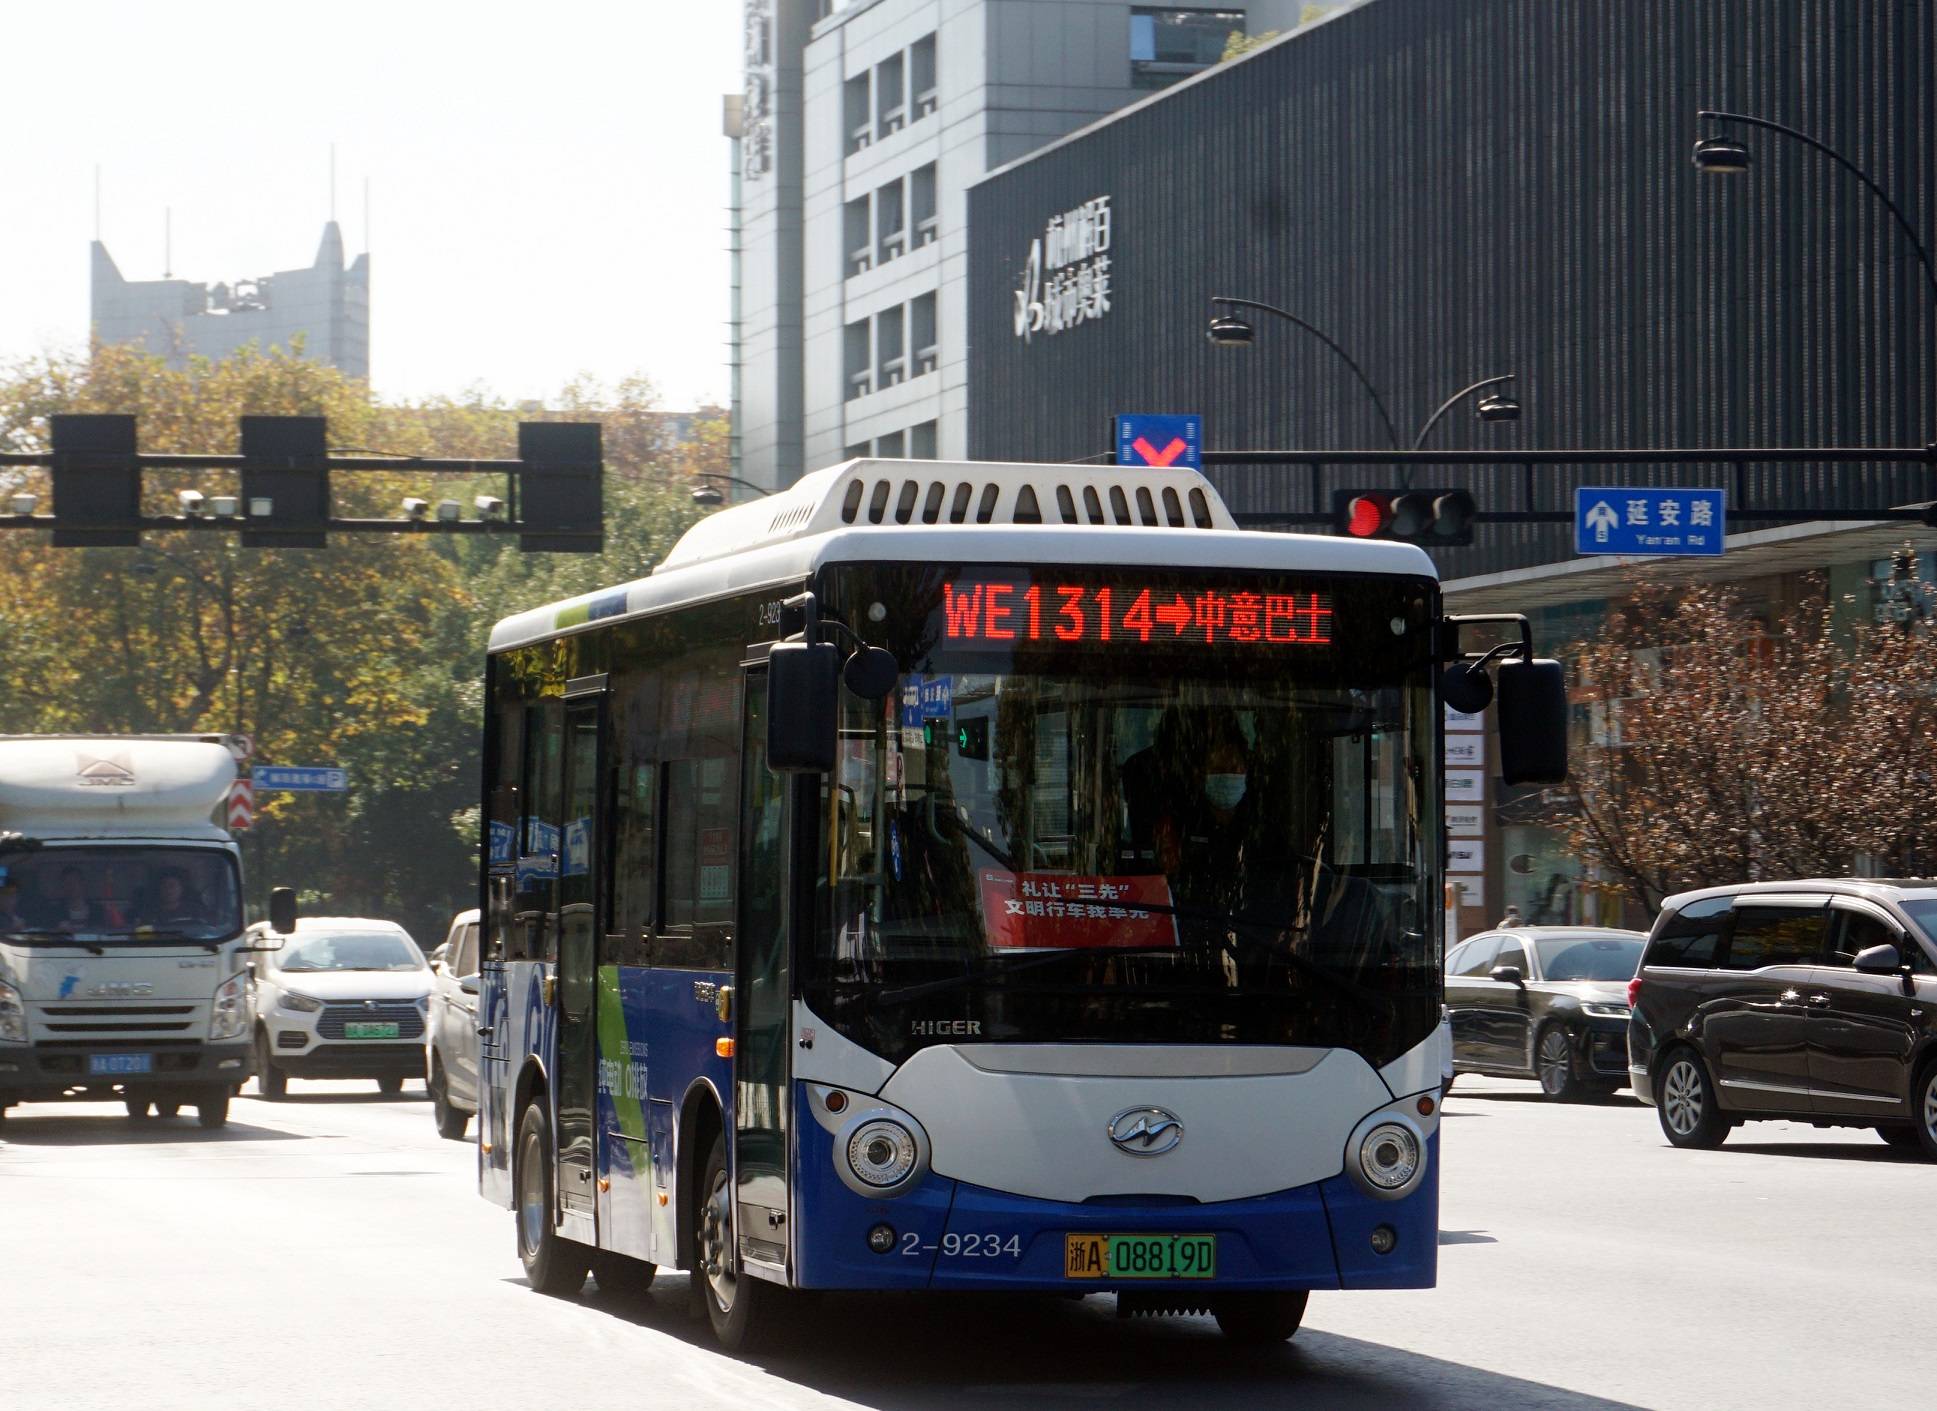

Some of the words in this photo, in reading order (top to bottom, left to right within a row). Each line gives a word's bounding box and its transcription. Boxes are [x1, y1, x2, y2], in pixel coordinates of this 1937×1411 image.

[1626, 499, 1713, 527] 延安路
[1687, 535, 1706, 546] Rd
[759, 601, 781, 626] 2-923
[944, 583, 1153, 642] WE1314
[1195, 591, 1333, 645] 中意巴士
[911, 1020, 982, 1036] HIGER
[901, 1232, 1021, 1258] 2-9234
